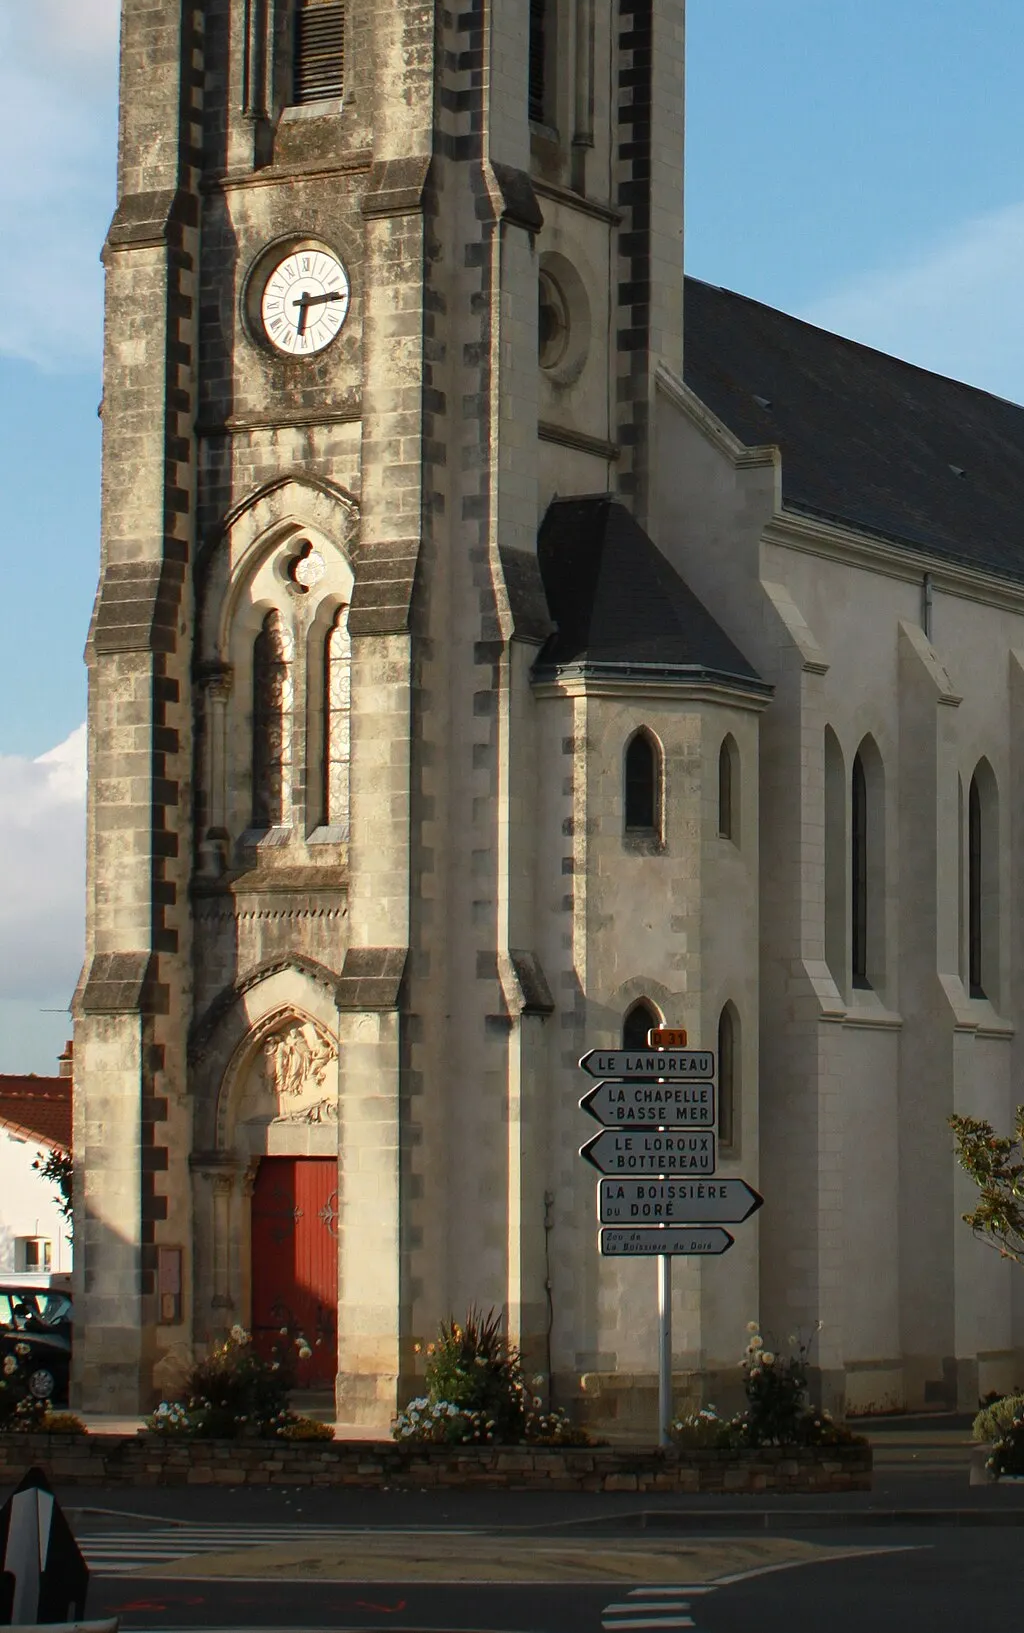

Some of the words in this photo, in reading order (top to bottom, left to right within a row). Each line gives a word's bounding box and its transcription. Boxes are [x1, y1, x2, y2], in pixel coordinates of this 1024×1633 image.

[653, 1032, 662, 1044] D
[668, 1032, 683, 1044] 31
[598, 1058, 616, 1071] LE
[626, 1057, 708, 1071] LANDREAU
[608, 1090, 625, 1103] LA
[635, 1090, 708, 1103] CHAPELLE
[608, 1108, 667, 1120] -BASSE
[676, 1108, 708, 1120] MER
[615, 1138, 633, 1151] LE
[644, 1137, 709, 1151] LOROUX
[608, 1155, 709, 1168] -BOTTEREAU
[606, 1186, 625, 1199] LA
[637, 1183, 727, 1199] BOISSIÈRE
[606, 1206, 621, 1217] DU
[630, 1201, 675, 1217] DORÉ
[606, 1232, 623, 1241] Zoo
[630, 1232, 641, 1241] de
[606, 1243, 617, 1251] La
[673, 1241, 684, 1250] du
